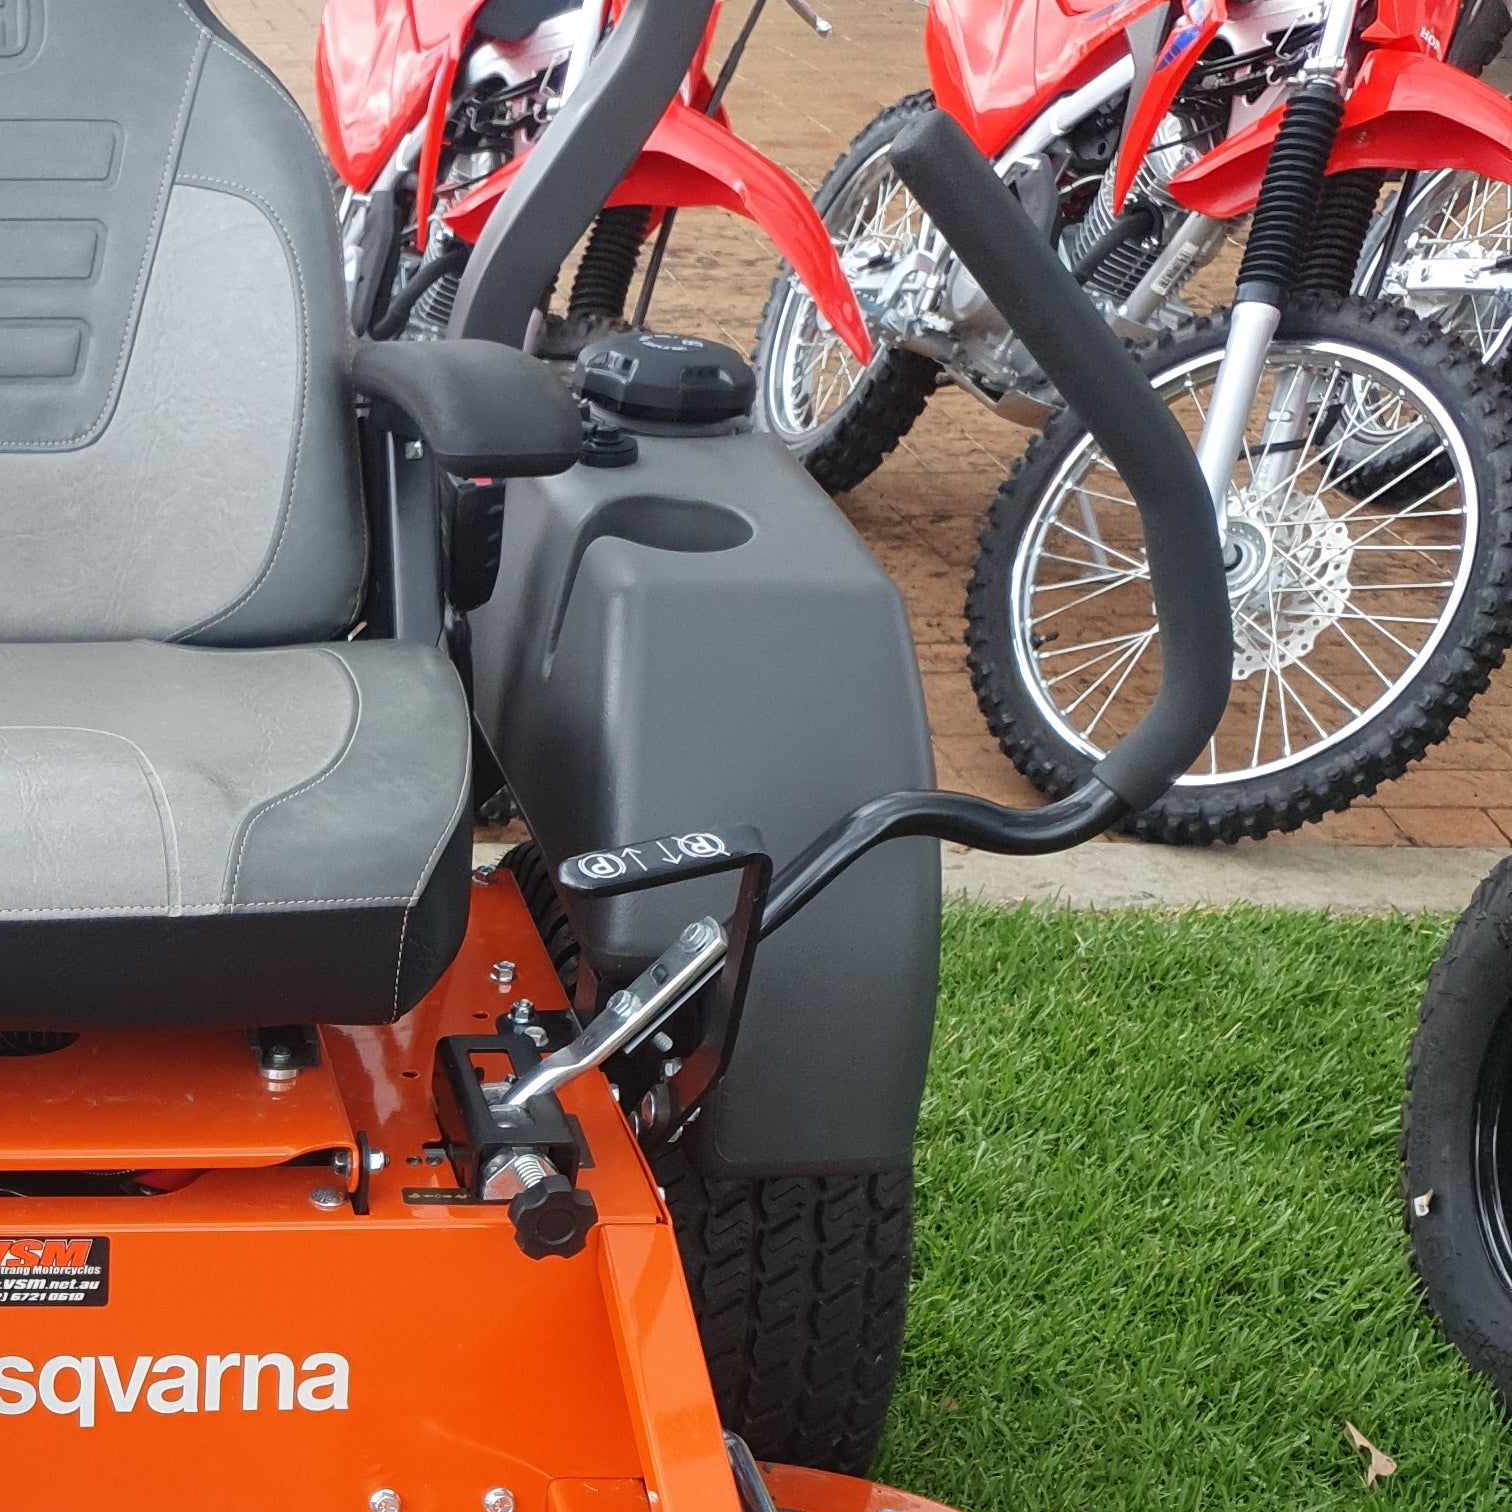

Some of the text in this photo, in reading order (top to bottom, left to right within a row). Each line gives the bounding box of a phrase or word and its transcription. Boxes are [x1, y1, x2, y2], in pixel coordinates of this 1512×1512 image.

[32, 1265, 101, 1275] Motorcycles
[10, 1292, 46, 1301] 6721
[47, 1292, 86, 1301] 0610
